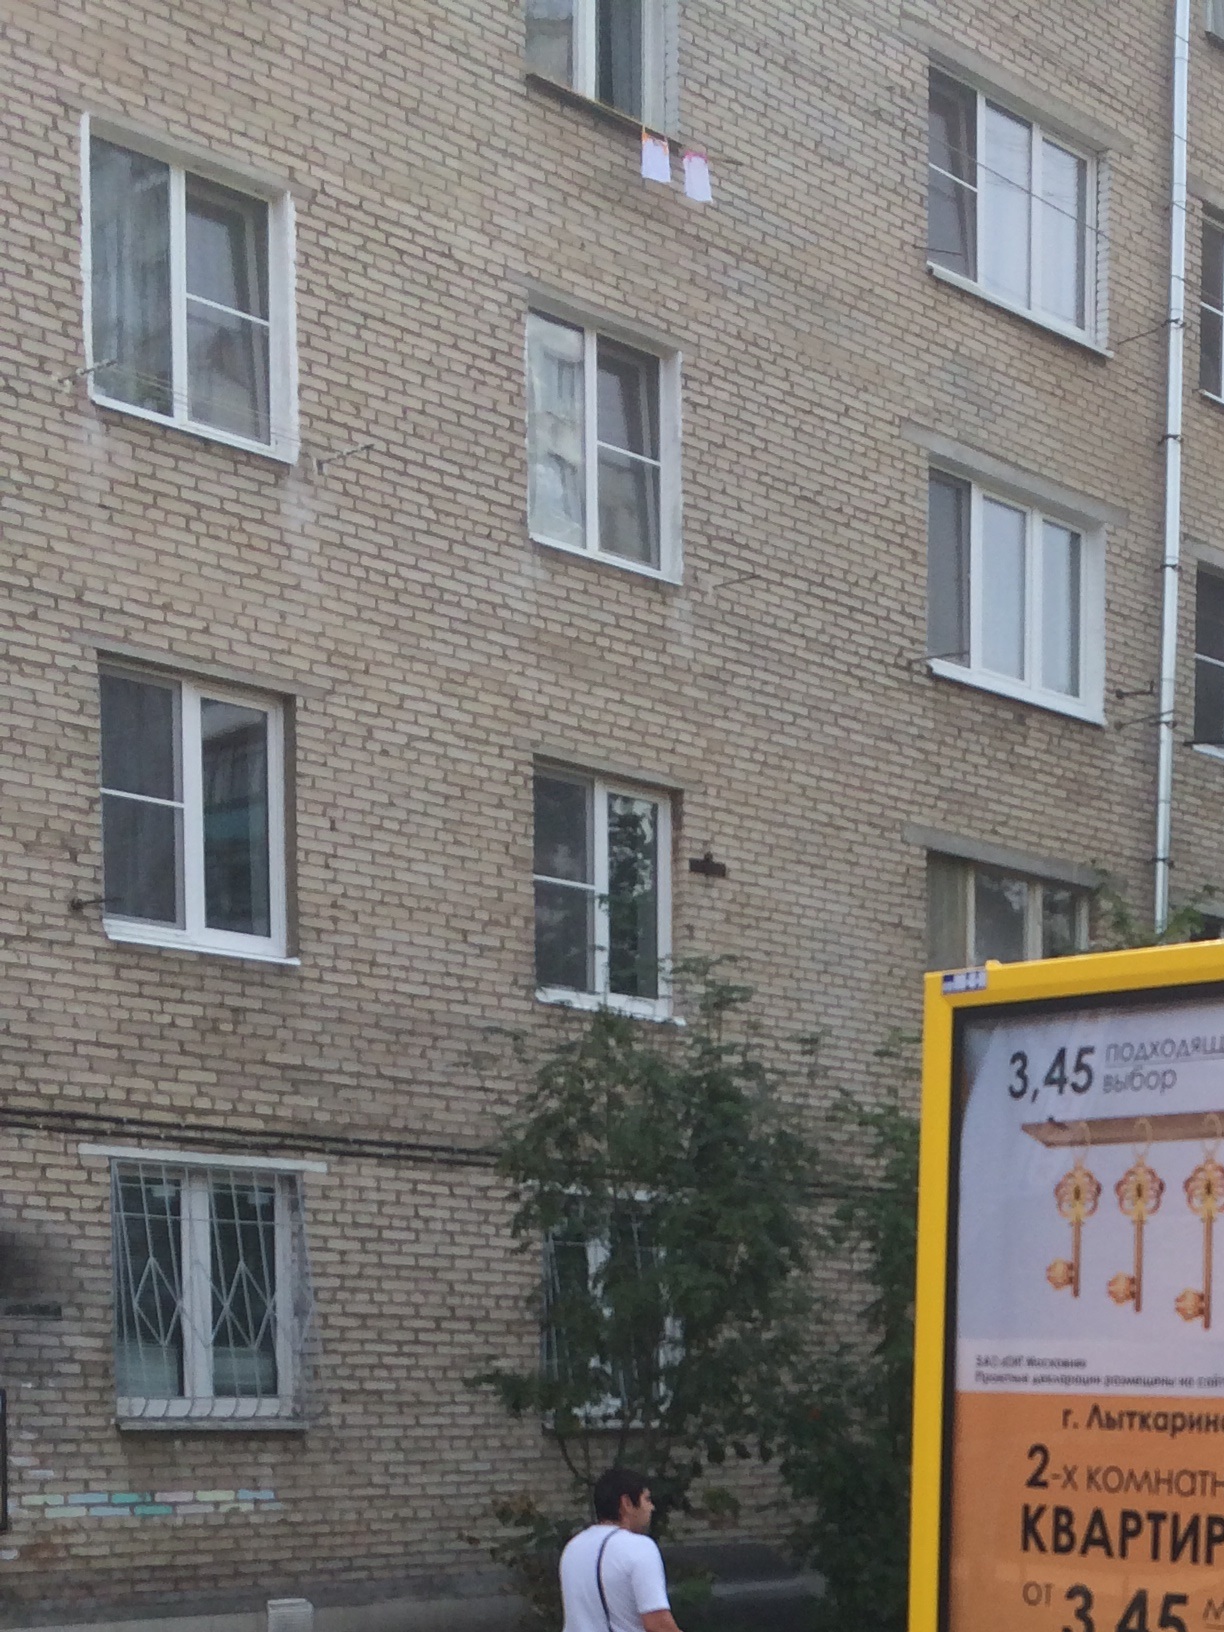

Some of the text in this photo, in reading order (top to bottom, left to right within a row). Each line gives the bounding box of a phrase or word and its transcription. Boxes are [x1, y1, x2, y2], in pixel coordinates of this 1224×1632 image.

[1009, 1046, 1096, 1103] 3,45
[1103, 1065, 1177, 1094] выбор
[1062, 1408, 1079, 1430] г.
[1026, 1443, 1079, 1491] 2-х
[1022, 1581, 1053, 1607] от
